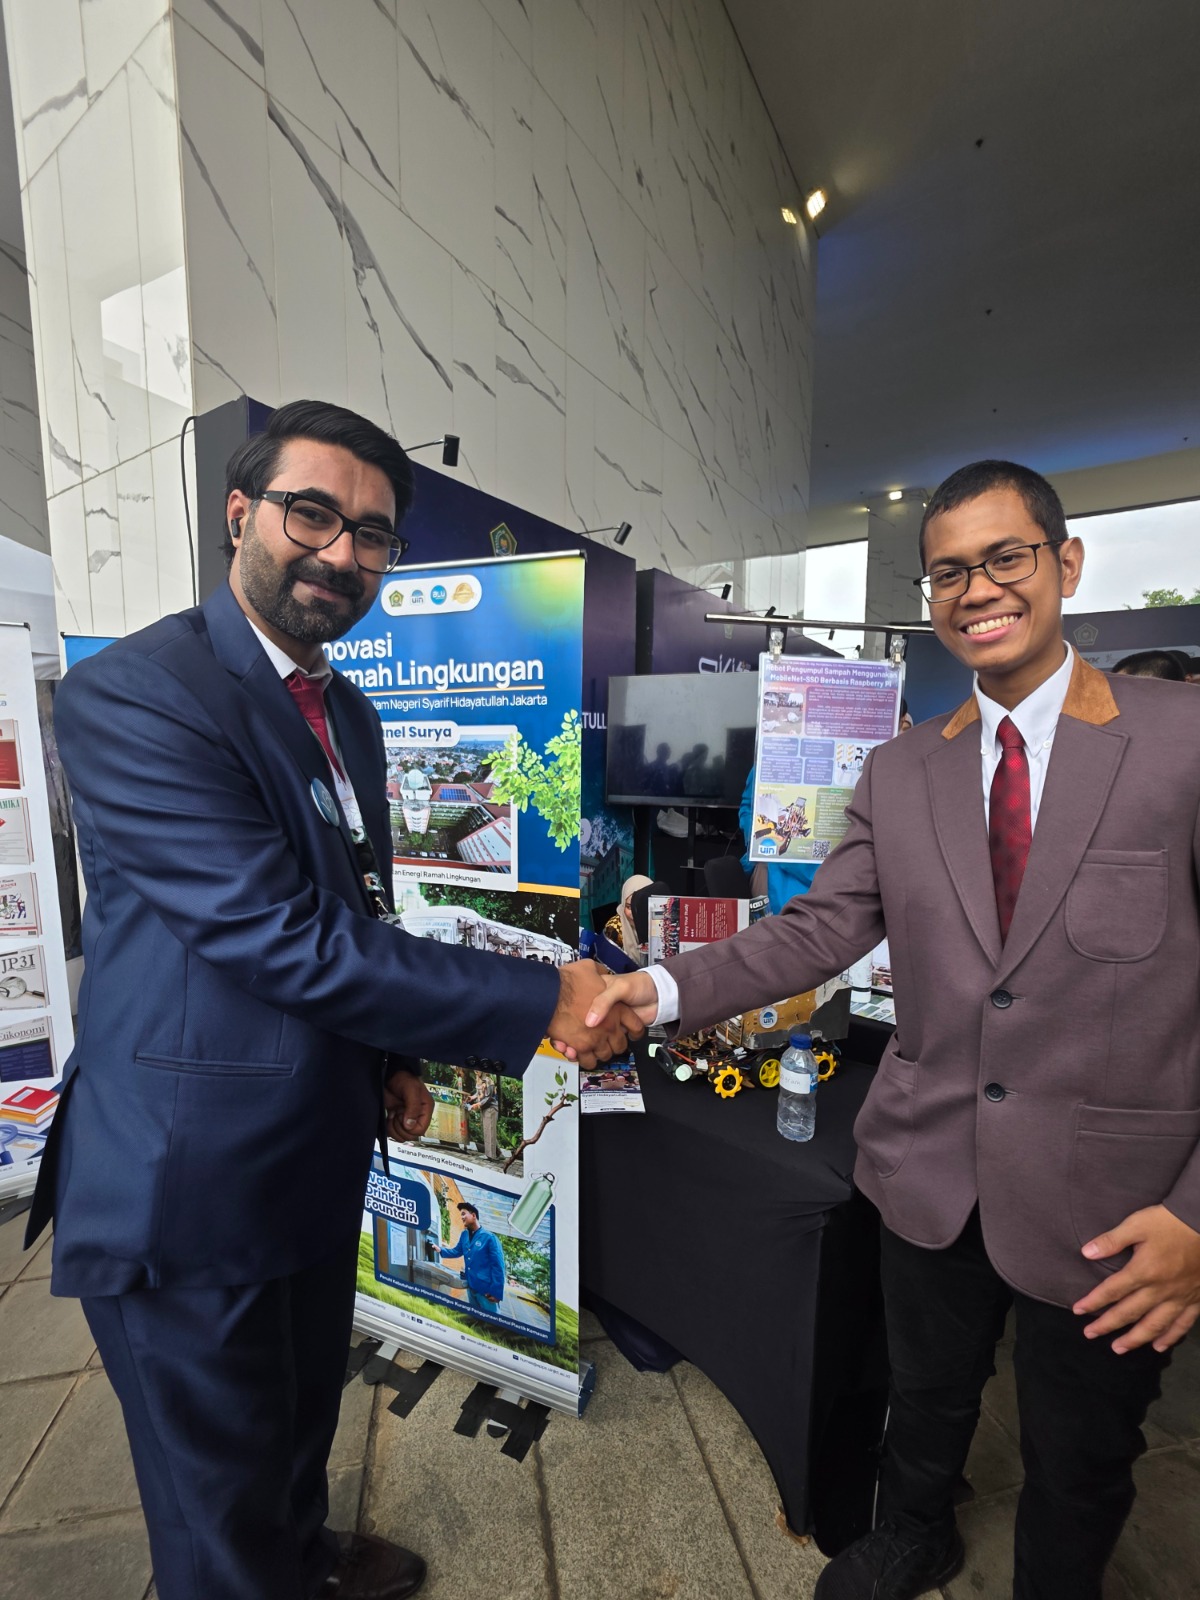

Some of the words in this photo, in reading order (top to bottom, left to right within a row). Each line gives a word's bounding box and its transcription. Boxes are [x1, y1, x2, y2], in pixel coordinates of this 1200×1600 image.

[411, 596, 424, 604] uin
[397, 658, 544, 691] Lingkungan
[765, 663, 786, 672] Robot
[786, 665, 824, 675] Pengumpul
[824, 667, 851, 677] Sampah
[852, 669, 898, 679] Menggunakan
[770, 673, 820, 683] MobileNet-SSD
[820, 677, 849, 686] Berbasis
[850, 678, 884, 689] Raspberry
[391, 699, 421, 713] Negeri
[422, 697, 450, 711] Syarif
[451, 695, 509, 710] Hidayatullah
[510, 694, 548, 706] Jakarta
[580, 712, 607, 730] TULL
[383, 726, 405, 738] nel
[409, 726, 452, 742] Surya
[760, 846, 775, 854] uin
[392, 868, 402, 877] an
[402, 869, 422, 879] Energi
[423, 871, 446, 880] Ramah
[446, 873, 481, 883] Lingkungan
[2, 954, 36, 974] JP3I
[397, 1146, 417, 1157] Sarana
[417, 1151, 441, 1164] Penting
[441, 1157, 474, 1174] Kebersihan
[366, 1183, 417, 1213] Drinking
[365, 1196, 419, 1225] Fountain
